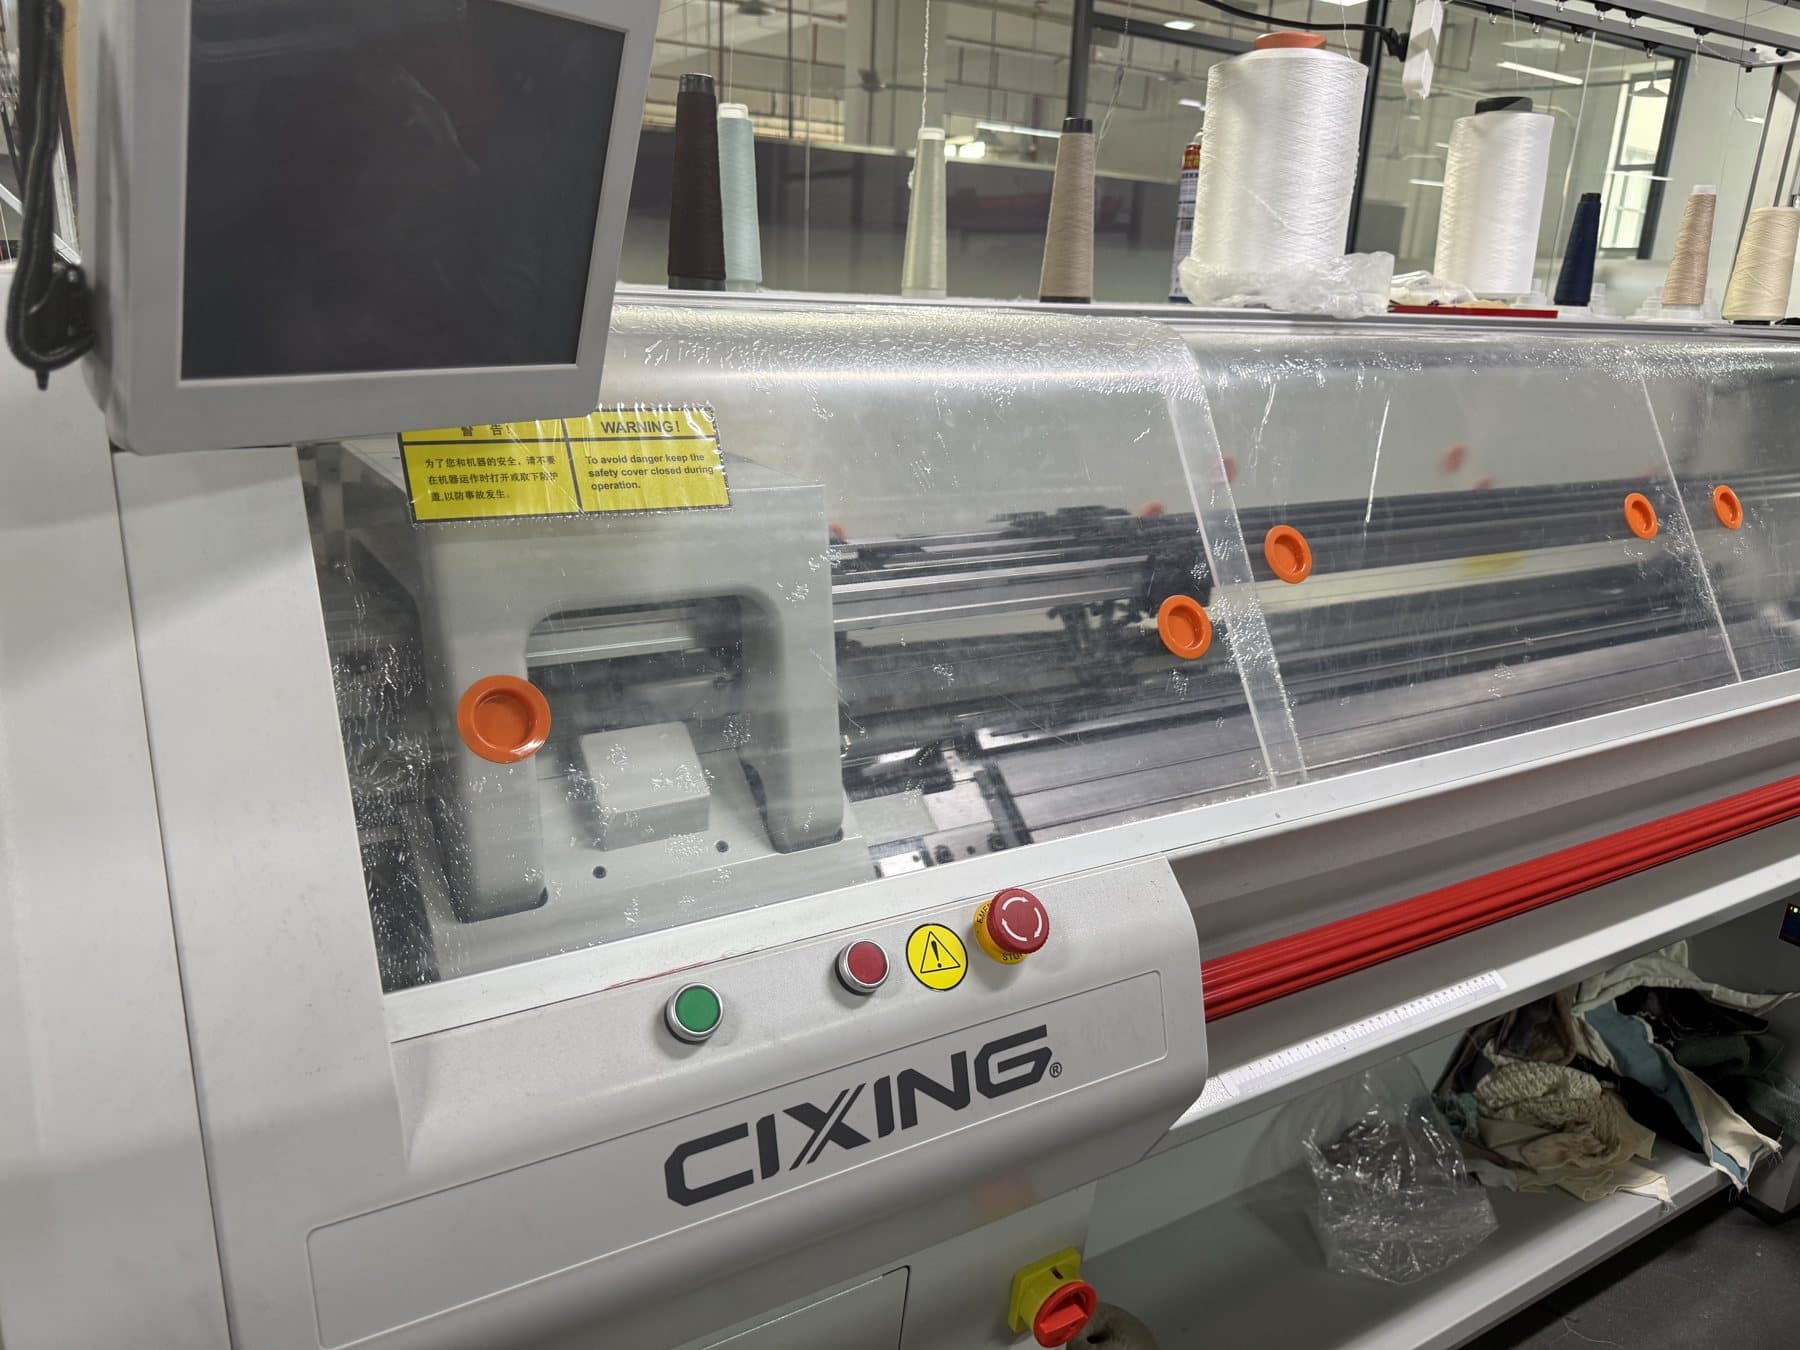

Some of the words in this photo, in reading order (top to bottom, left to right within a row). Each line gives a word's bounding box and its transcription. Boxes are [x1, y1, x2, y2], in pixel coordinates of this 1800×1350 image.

[585, 455, 598, 465] To
[600, 454, 628, 464] avoid
[630, 453, 664, 465] danger
[665, 453, 688, 464] keep
[690, 452, 705, 461] the
[588, 468, 618, 478] safety
[621, 467, 648, 476] cover
[650, 465, 682, 475] closed
[684, 463, 714, 475] during
[591, 480, 641, 491] operation.
